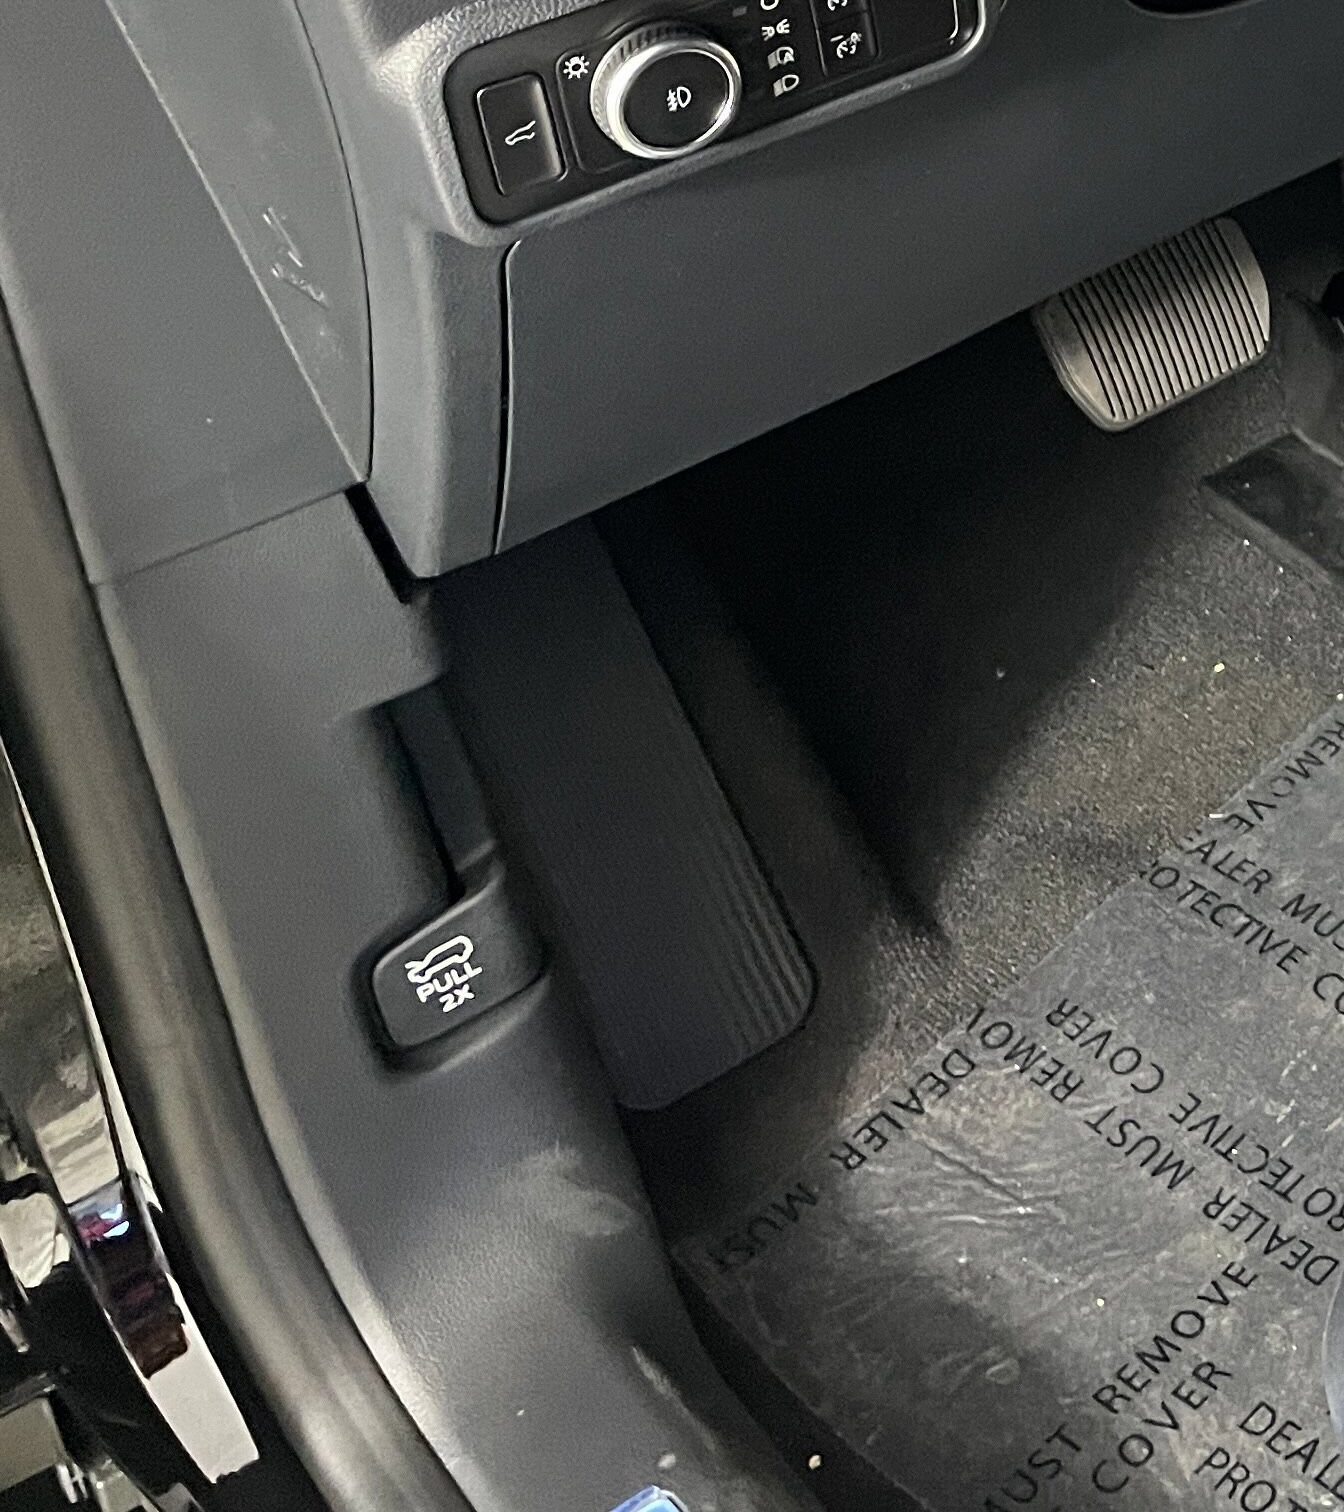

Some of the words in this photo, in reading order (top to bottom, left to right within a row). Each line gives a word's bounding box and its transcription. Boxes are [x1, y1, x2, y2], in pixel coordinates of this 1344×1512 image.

[1139, 860, 1308, 974] OTECTIVE
[415, 961, 483, 1003] PULL
[438, 983, 475, 1013] 2X
[1044, 997, 1165, 1095] COVER
[829, 1048, 976, 1171] DEALER
[1084, 1105, 1196, 1190] MUST
[1203, 1187, 1341, 1287] DEALER
[985, 1422, 1082, 1512] UST
[1091, 1260, 1260, 1415] REMOVE
[1092, 1360, 1233, 1495] COVER
